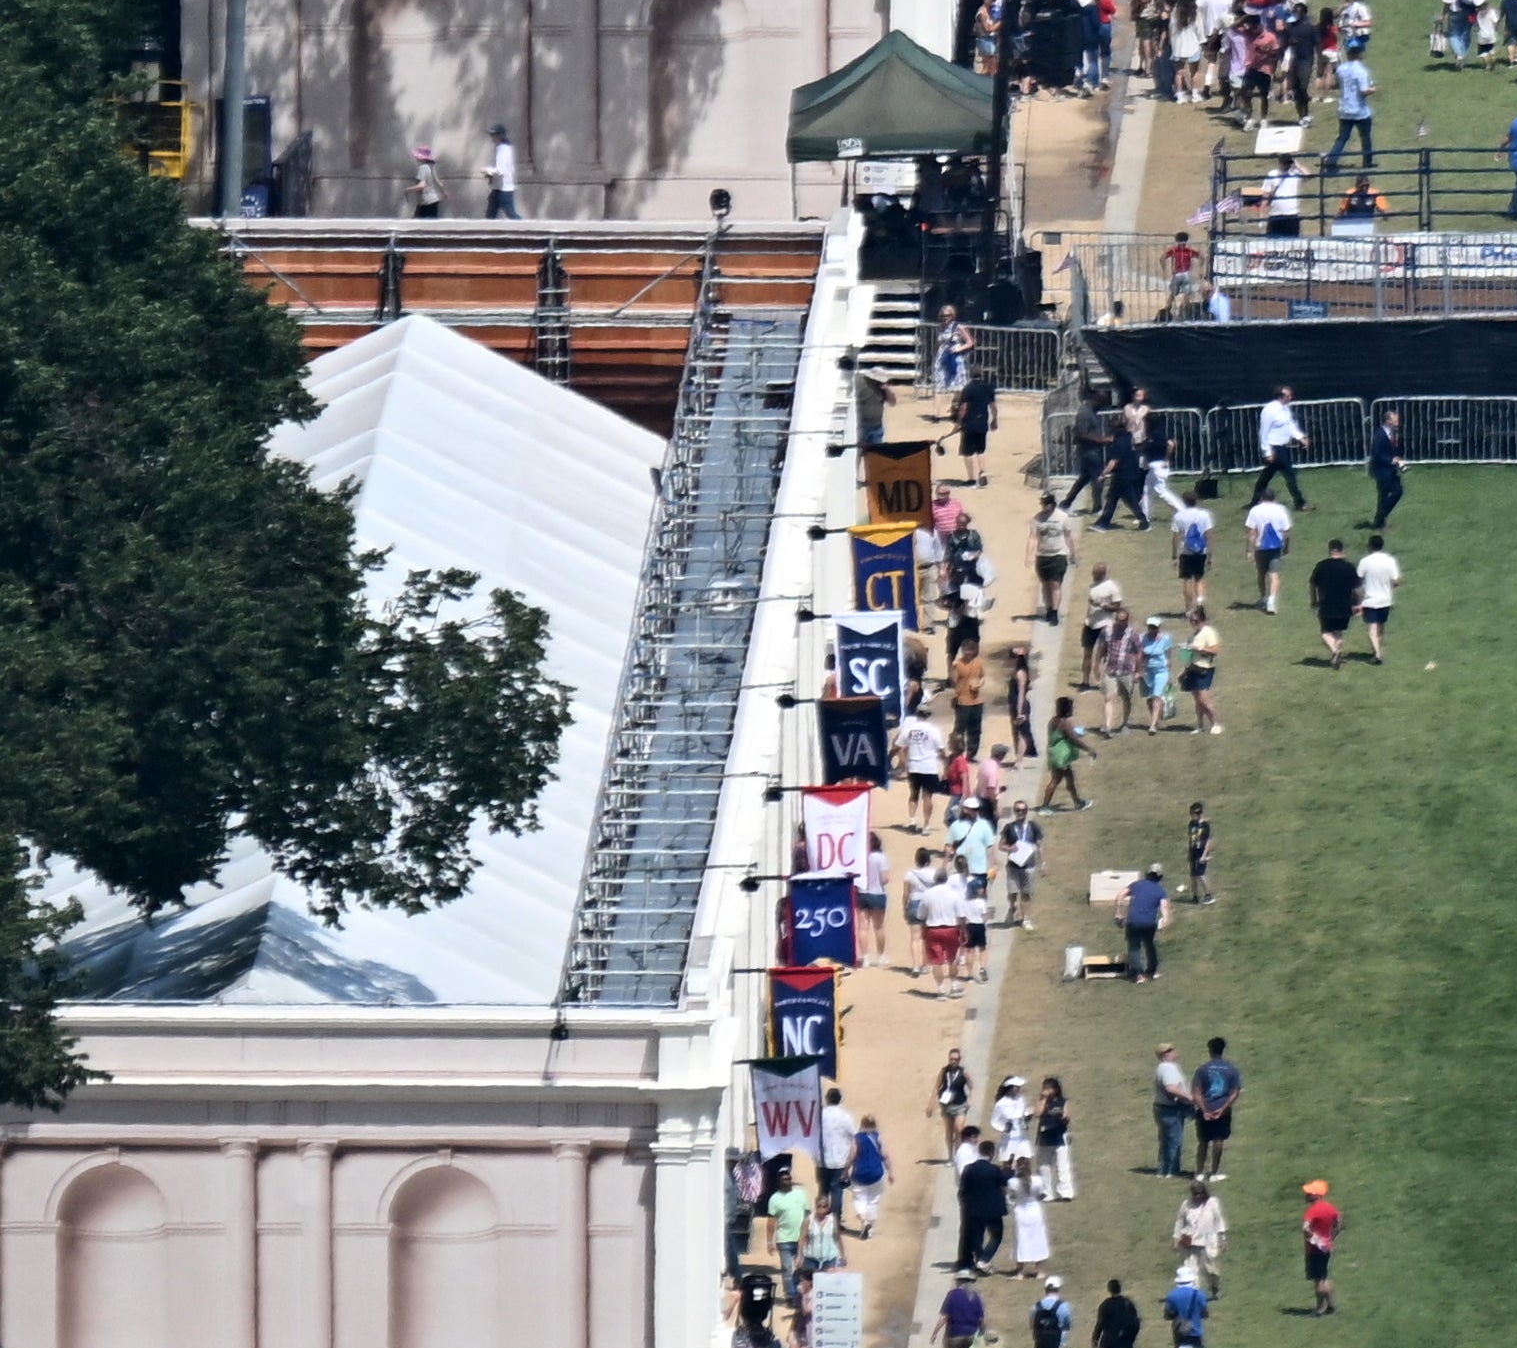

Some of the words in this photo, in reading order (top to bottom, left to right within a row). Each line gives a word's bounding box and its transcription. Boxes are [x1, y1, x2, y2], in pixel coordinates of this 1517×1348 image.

[877, 480, 923, 514] MD
[866, 570, 905, 611] CT
[849, 657, 892, 696] SC
[831, 733, 876, 766] VA
[816, 832, 855, 870] DC
[795, 907, 847, 937] 250
[782, 1015, 826, 1056] NC
[761, 1100, 816, 1138] WV
